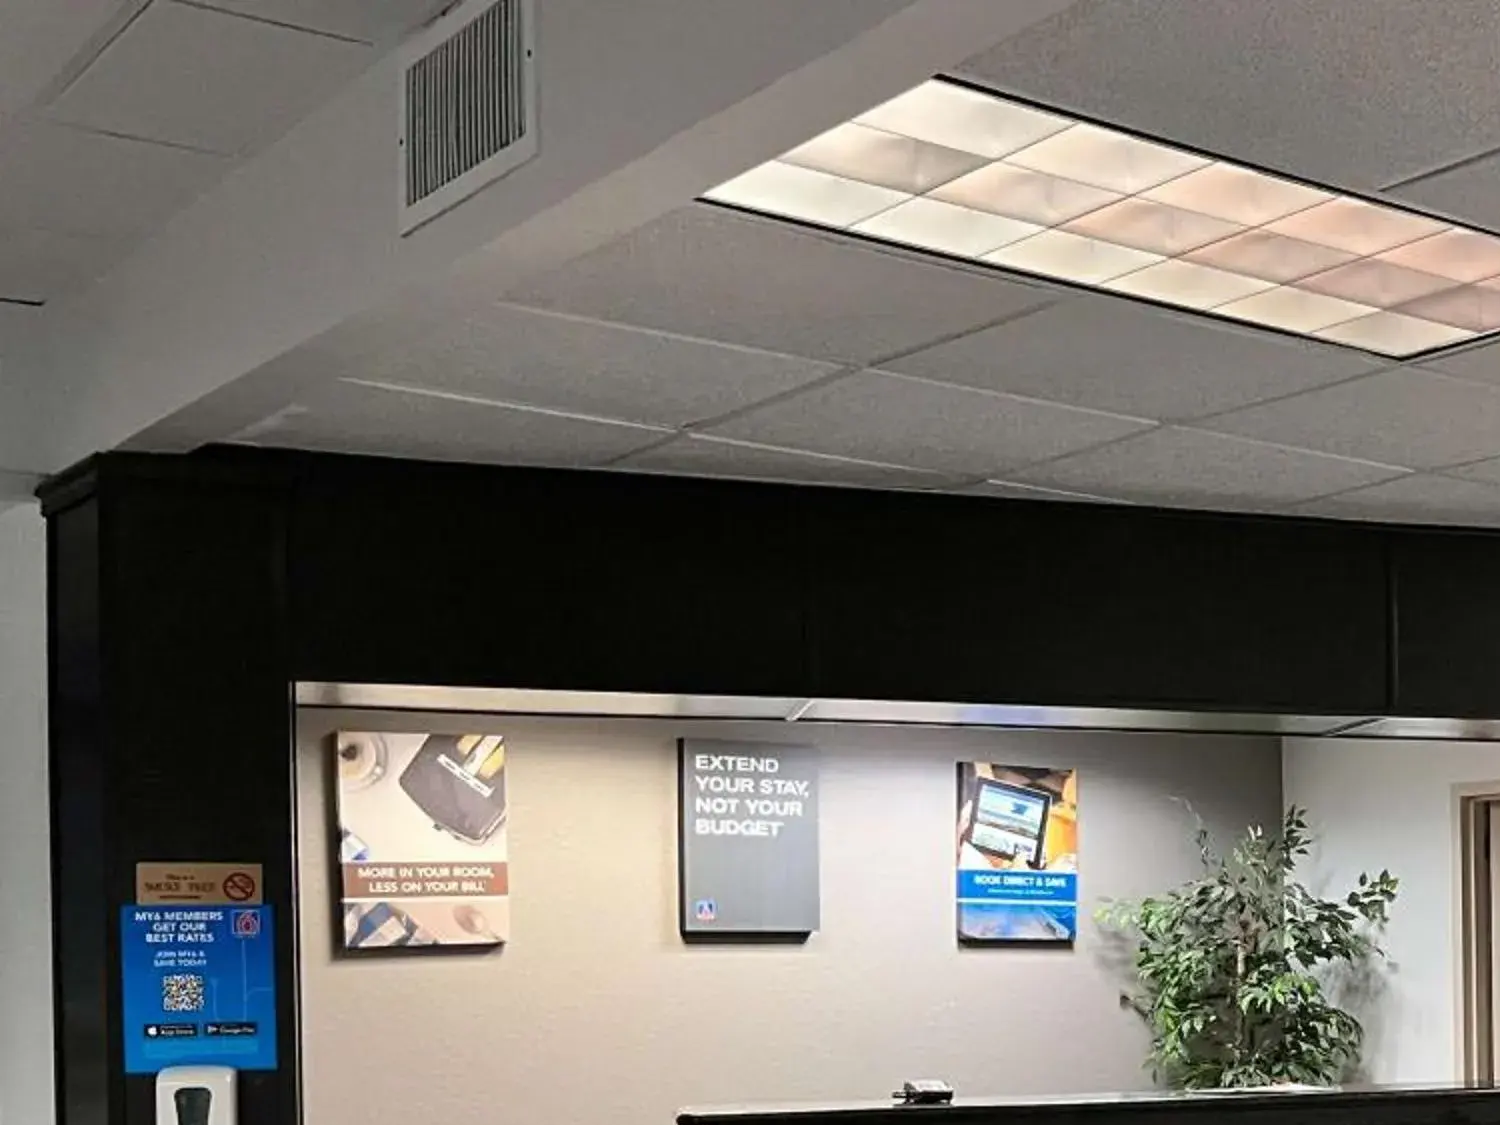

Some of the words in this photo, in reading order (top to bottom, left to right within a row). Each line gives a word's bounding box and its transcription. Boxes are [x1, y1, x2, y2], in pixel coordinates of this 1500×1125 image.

[695, 754, 779, 773] EXTEND
[694, 775, 755, 793] YOUR
[760, 779, 809, 799] STAY,
[695, 797, 740, 814] NOT
[744, 799, 803, 817] YOUR
[695, 818, 785, 837] BUDGET
[358, 866, 396, 879] MORE
[399, 866, 413, 878] IN
[416, 866, 451, 878] YOUR
[369, 881, 399, 893] LESS
[401, 881, 421, 893] ON
[424, 881, 459, 893] YOUR
[164, 912, 224, 921] MEMBERS
[153, 922, 177, 932] GET
[179, 922, 207, 932] OUR
[145, 933, 176, 943] BEST
[178, 933, 215, 943] RATES
